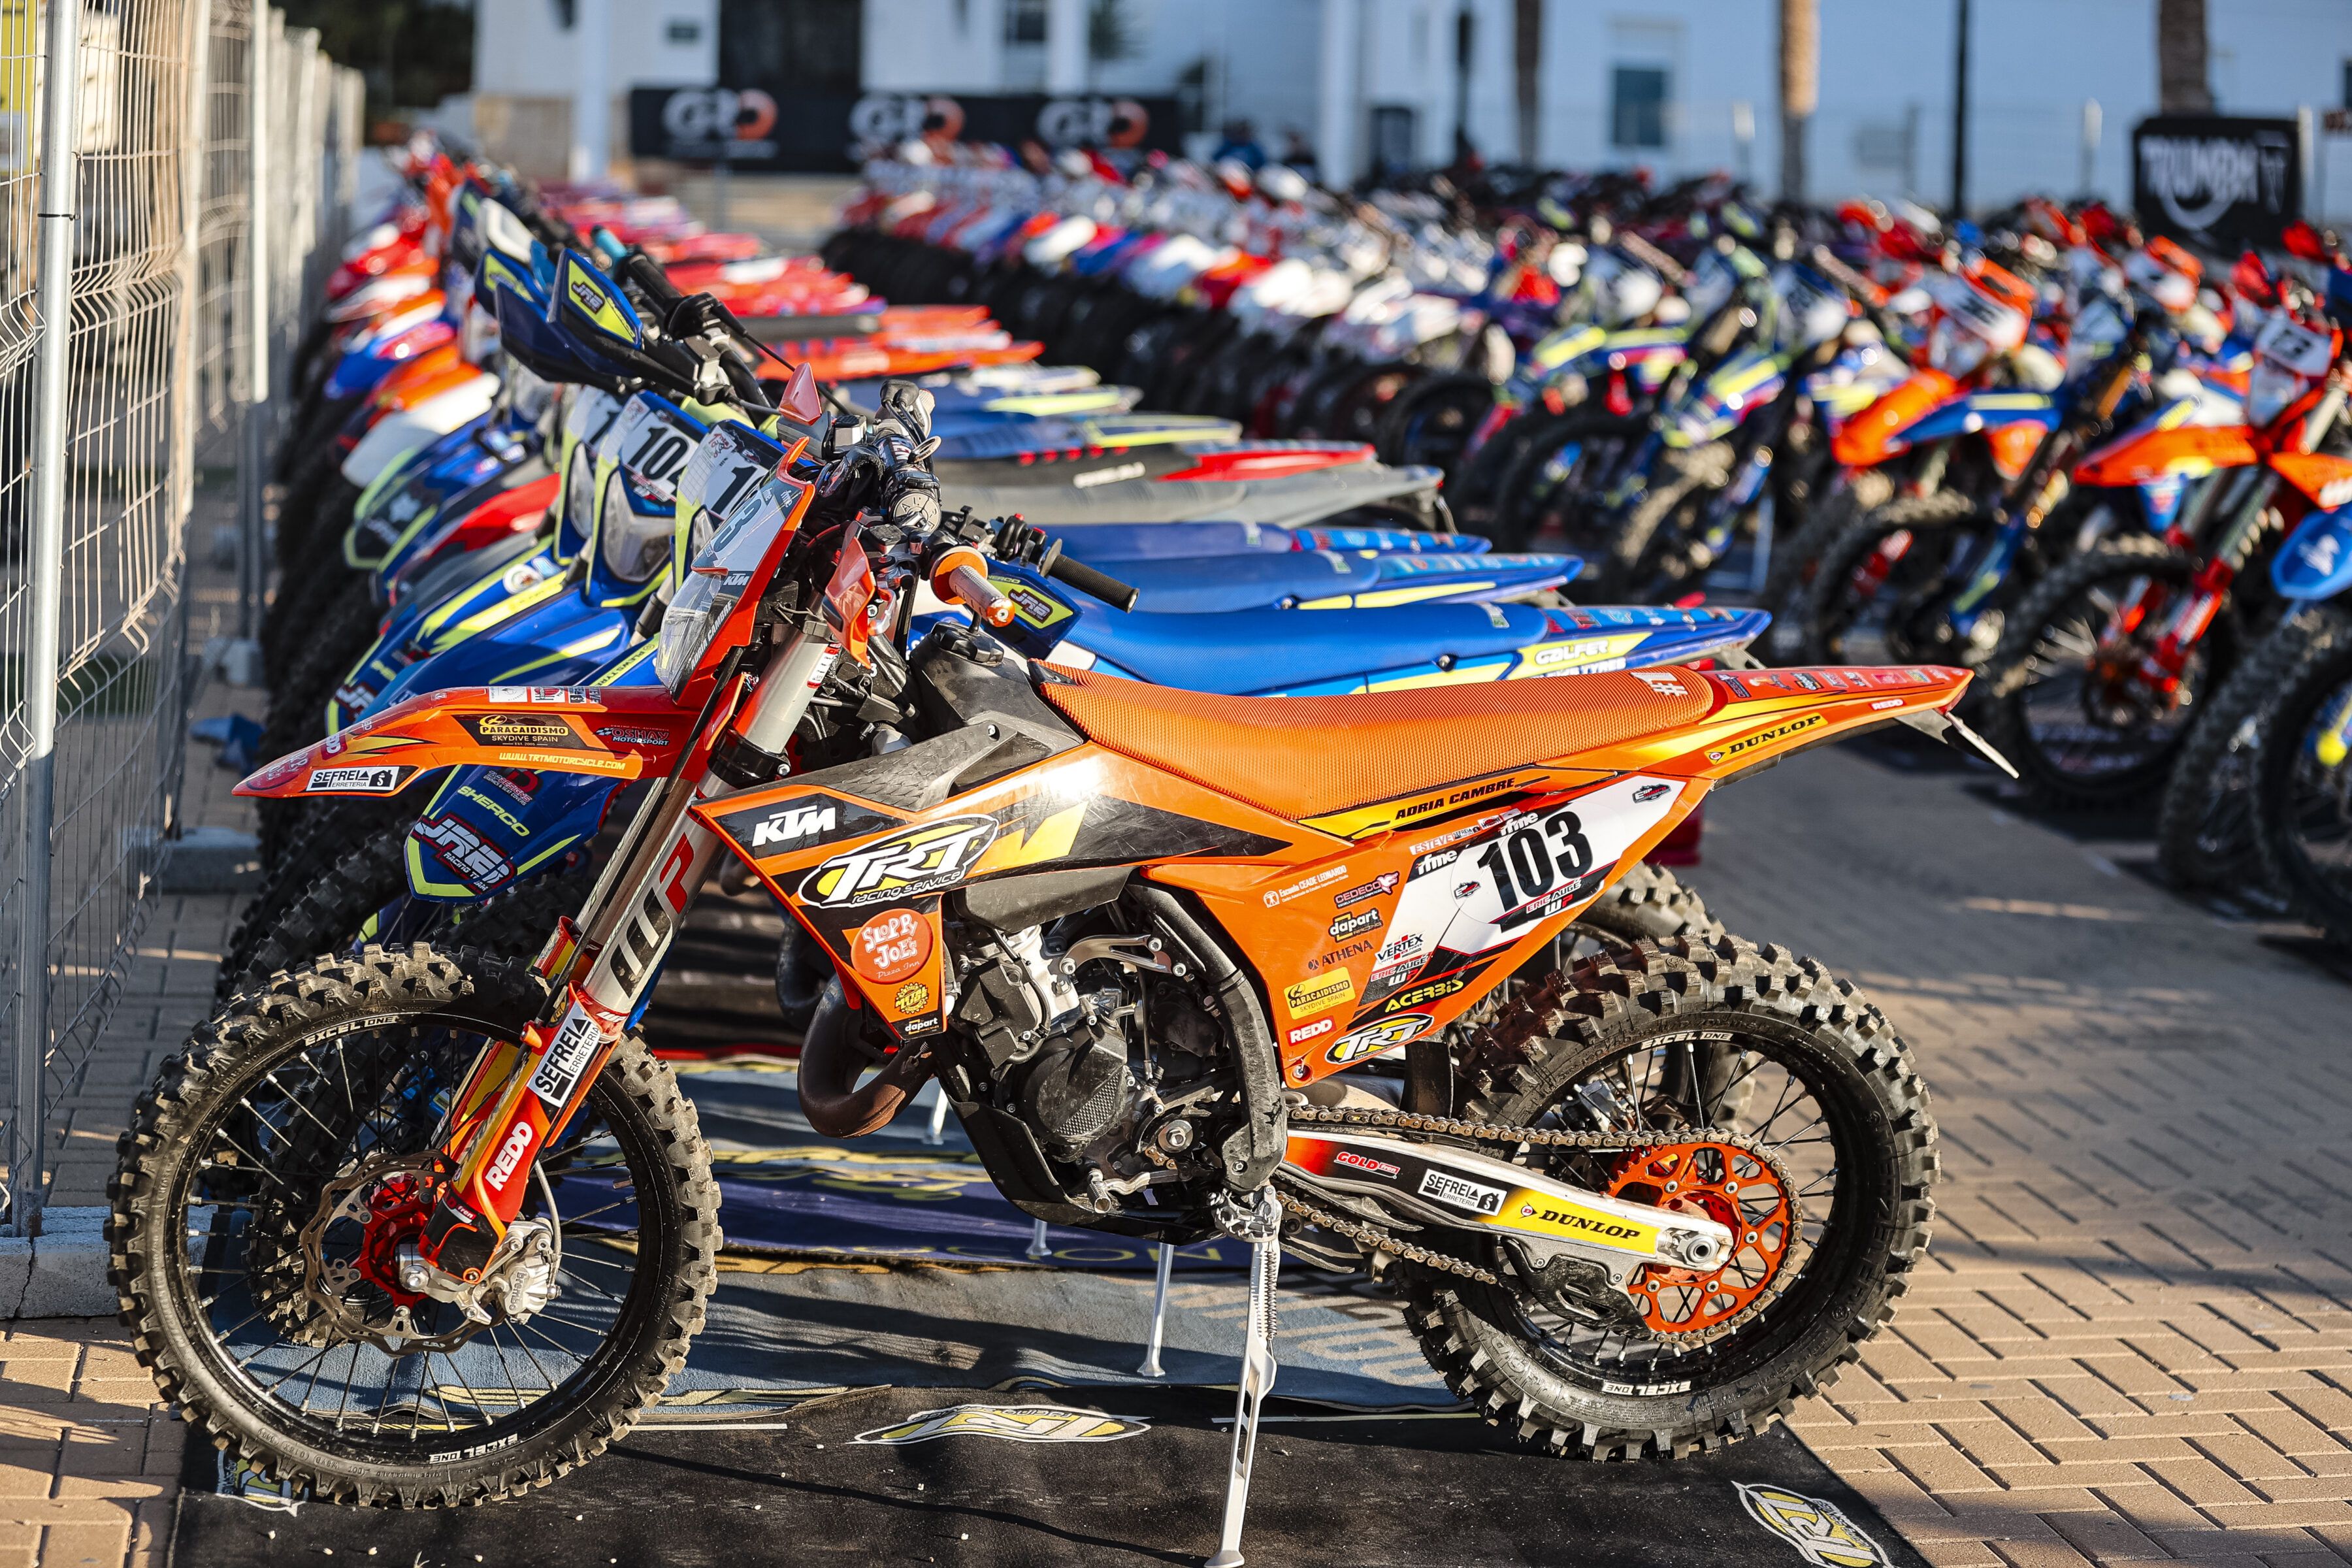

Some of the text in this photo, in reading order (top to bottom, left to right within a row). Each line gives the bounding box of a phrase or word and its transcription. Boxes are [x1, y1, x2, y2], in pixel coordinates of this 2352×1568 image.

[724, 574, 748, 585] KTM
[690, 599, 732, 670] ADRIA CAMBRE
[1535, 640, 1608, 665] GALFER
[1729, 715, 1821, 755] DUNLOP
[499, 752, 625, 770] WWW.TRTMOTORCYCLE.COM
[457, 785, 530, 837] SHERCO
[511, 792, 527, 806] COVERS
[1396, 777, 1516, 819] ADRIA CAMBRE
[753, 806, 836, 847] KTM
[1414, 834, 1452, 853] ESTEVE
[444, 852, 472, 874] RACING
[821, 823, 996, 902] TRT
[1477, 811, 1592, 911] 103
[852, 871, 960, 904] racing service
[1279, 865, 1347, 897] Escuela CEADE LEONARDO
[1335, 881, 1381, 904] CEDECO
[1330, 909, 1378, 936] dapart
[1353, 922, 1382, 935] RACING
[1322, 939, 1373, 966] ATHENA
[1377, 934, 1423, 960] VERTEX
[877, 961, 920, 979] Pizza Inn
[1371, 968, 1396, 981] ERIC
[1290, 981, 1348, 1007] PARACAIDISMO
[1299, 992, 1346, 1013] SKYDIVE SPAIN
[305, 1017, 393, 1047] EXCEL ONE
[905, 1017, 938, 1032] dapart
[1290, 1019, 1333, 1043] REDD
[1336, 1018, 1432, 1063] TRT
[1641, 1033, 1697, 1050] EXCEL
[486, 1122, 533, 1191] REDD
[1337, 1152, 1397, 1174] GOLD fren
[1539, 1209, 1640, 1241] DUNLOP
[1605, 1380, 1691, 1396] EXCEL ONE
[433, 1433, 517, 1462] EXCEL ONE
